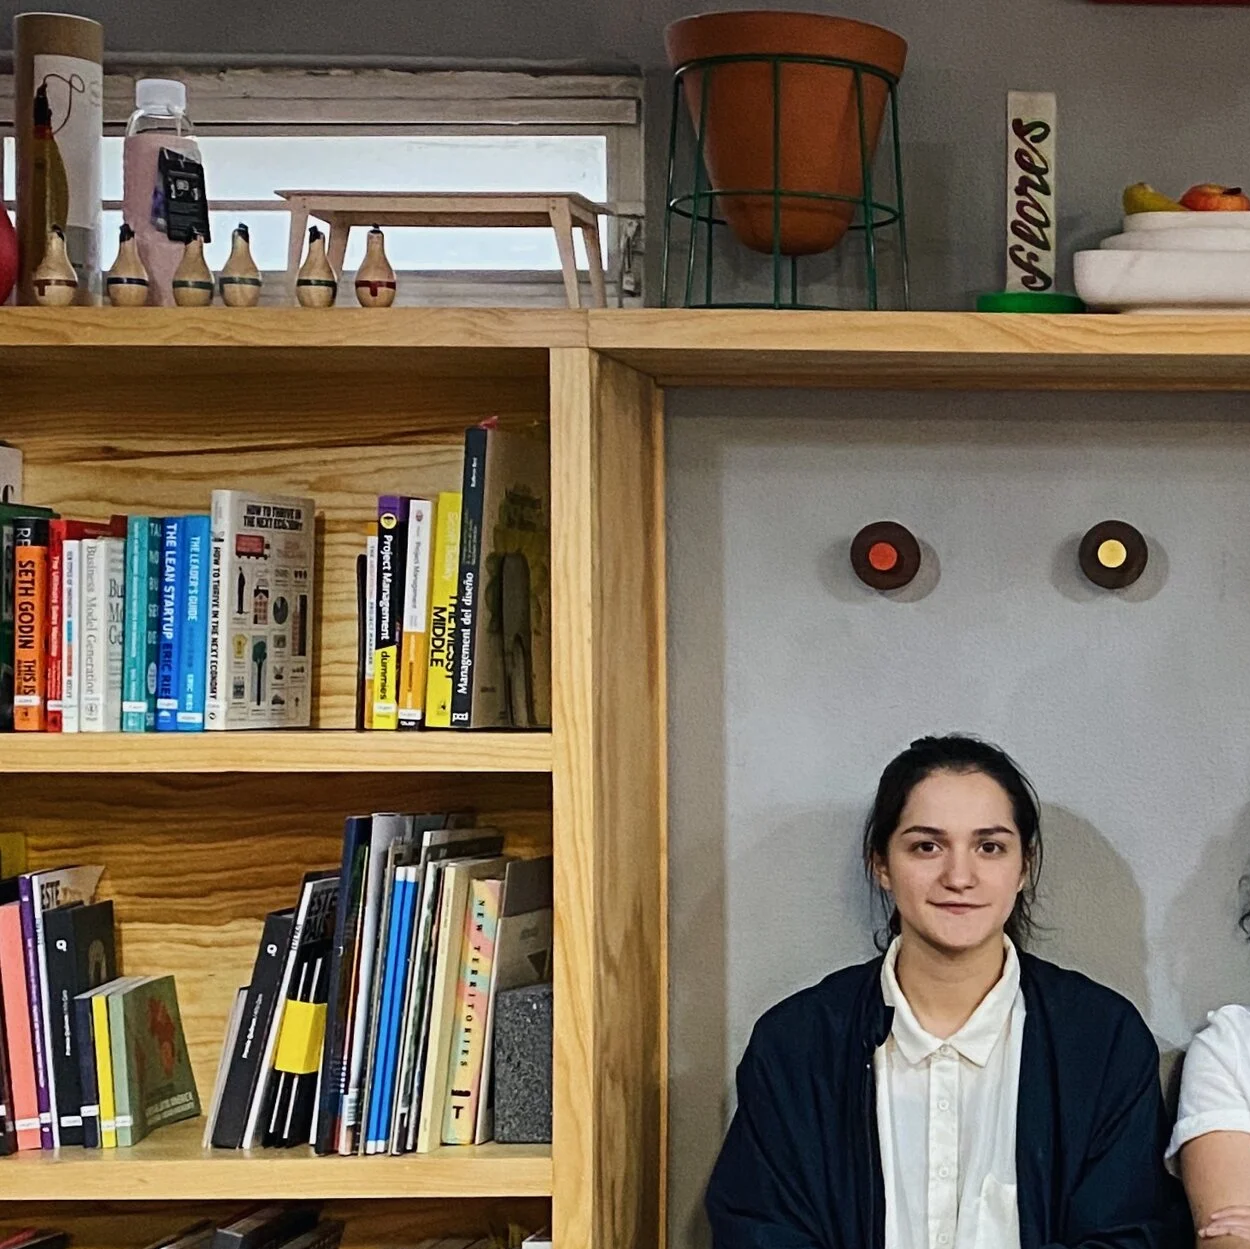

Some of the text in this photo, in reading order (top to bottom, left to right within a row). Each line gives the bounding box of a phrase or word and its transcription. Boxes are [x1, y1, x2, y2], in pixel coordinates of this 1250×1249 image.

[213, 568, 220, 577] TO
[413, 542, 421, 563] Project
[18, 560, 35, 649] SETH GODIN
[161, 523, 178, 672] THE LEAN STARTUP ERIC
[186, 537, 201, 693] THE LEADER'S GUIDE ERIC
[212, 611, 219, 619] IN
[379, 535, 394, 699] Project Management dummies
[462, 572, 474, 604] diseño
[462, 607, 472, 626] del
[85, 545, 98, 695] Business Model Generation
[430, 606, 447, 668] MIDDLE
[24, 660, 36, 696] THIS IS
[209, 660, 218, 700] ECONOMY
[457, 628, 471, 694] Management
[460, 899, 486, 1067] NEW TERRITORIES
